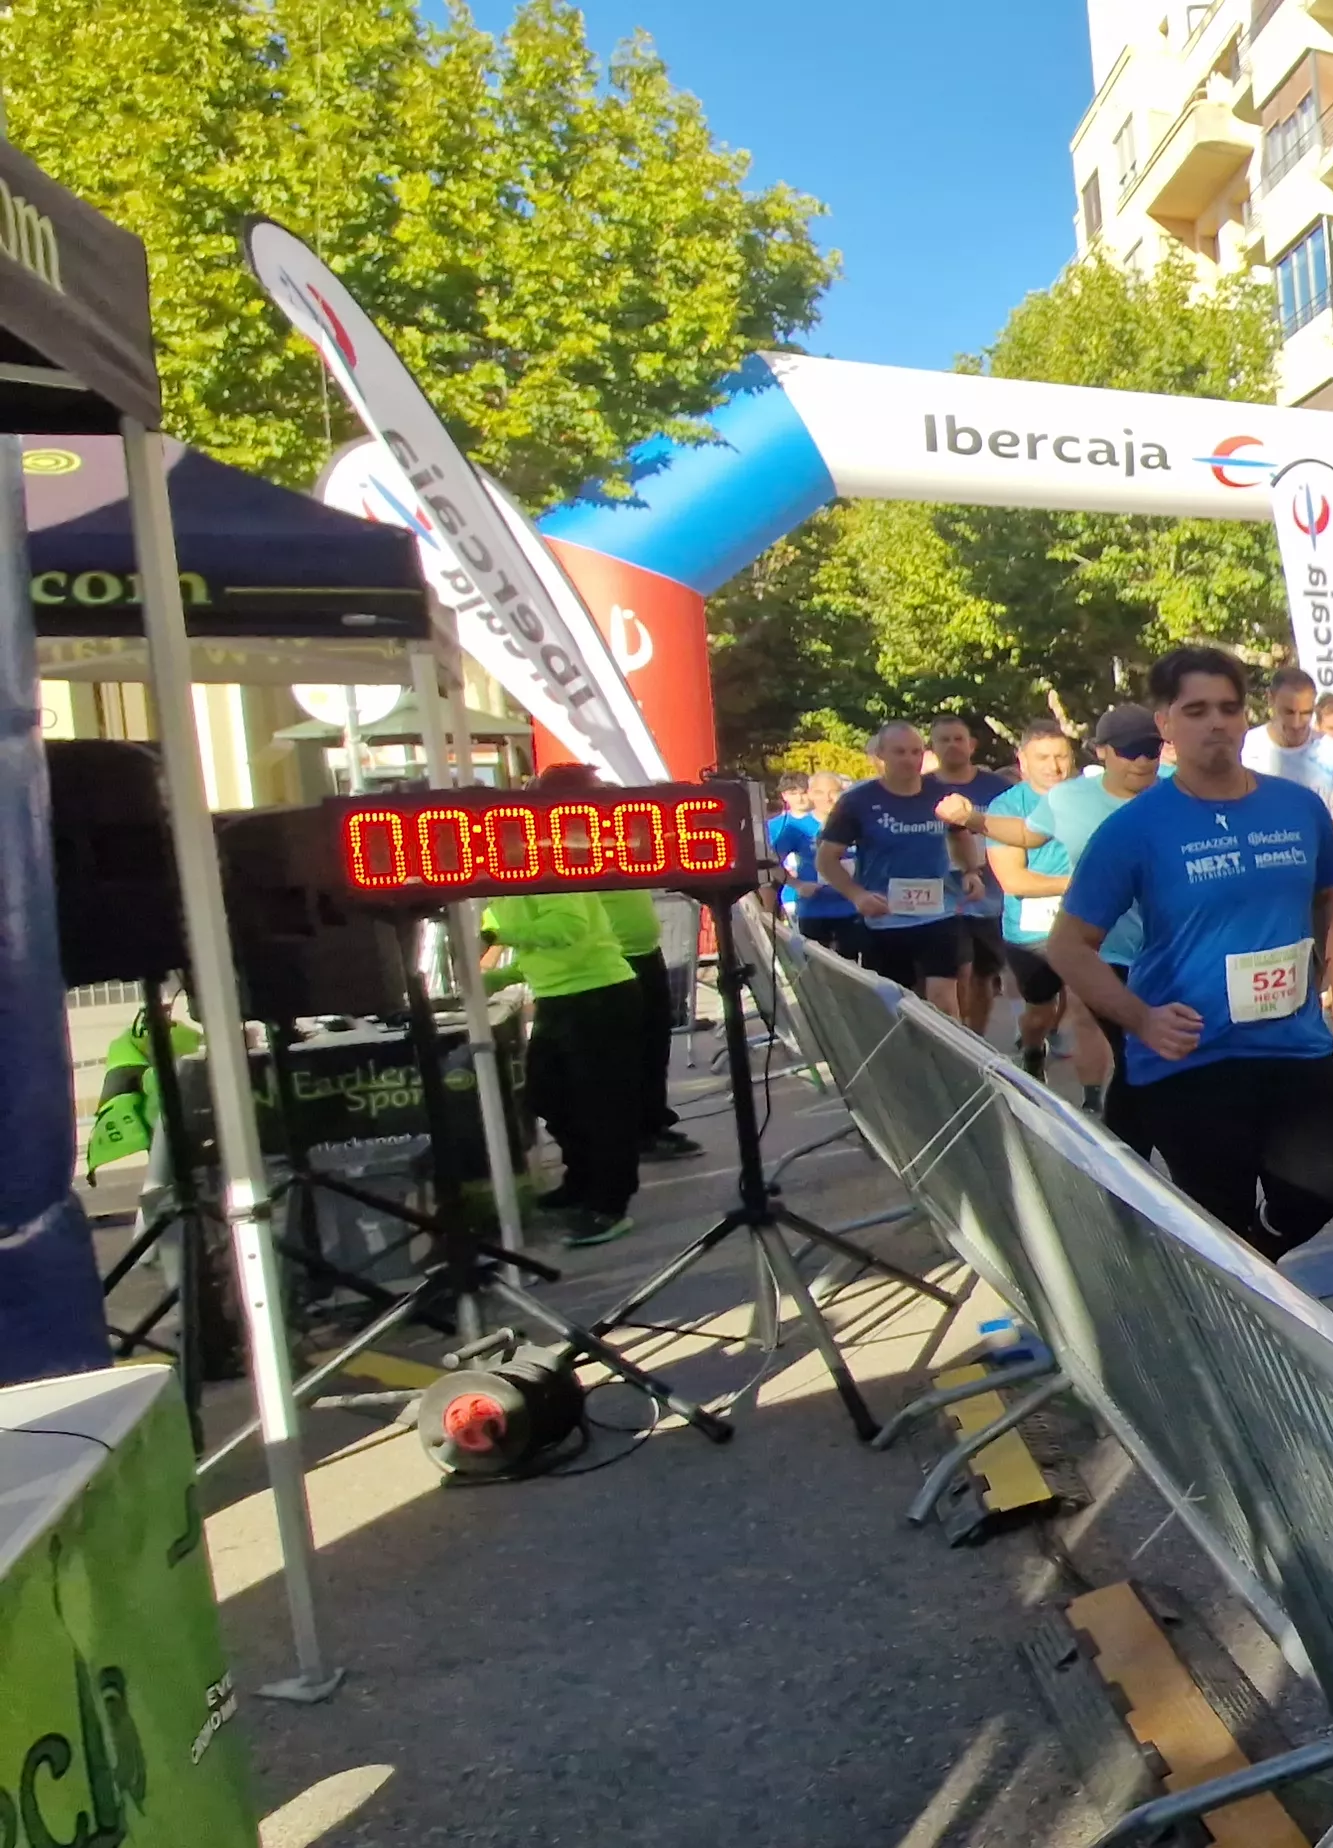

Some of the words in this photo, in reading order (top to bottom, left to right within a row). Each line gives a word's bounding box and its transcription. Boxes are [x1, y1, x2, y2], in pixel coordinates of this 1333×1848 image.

[924, 414, 1171, 477] Ibercaja
[347, 799, 730, 886] 00:00:06
[1186, 851, 1241, 876] NEXT
[902, 888, 931, 901] 371
[1252, 962, 1297, 992] 521
[346, 1086, 424, 1117] Spor
